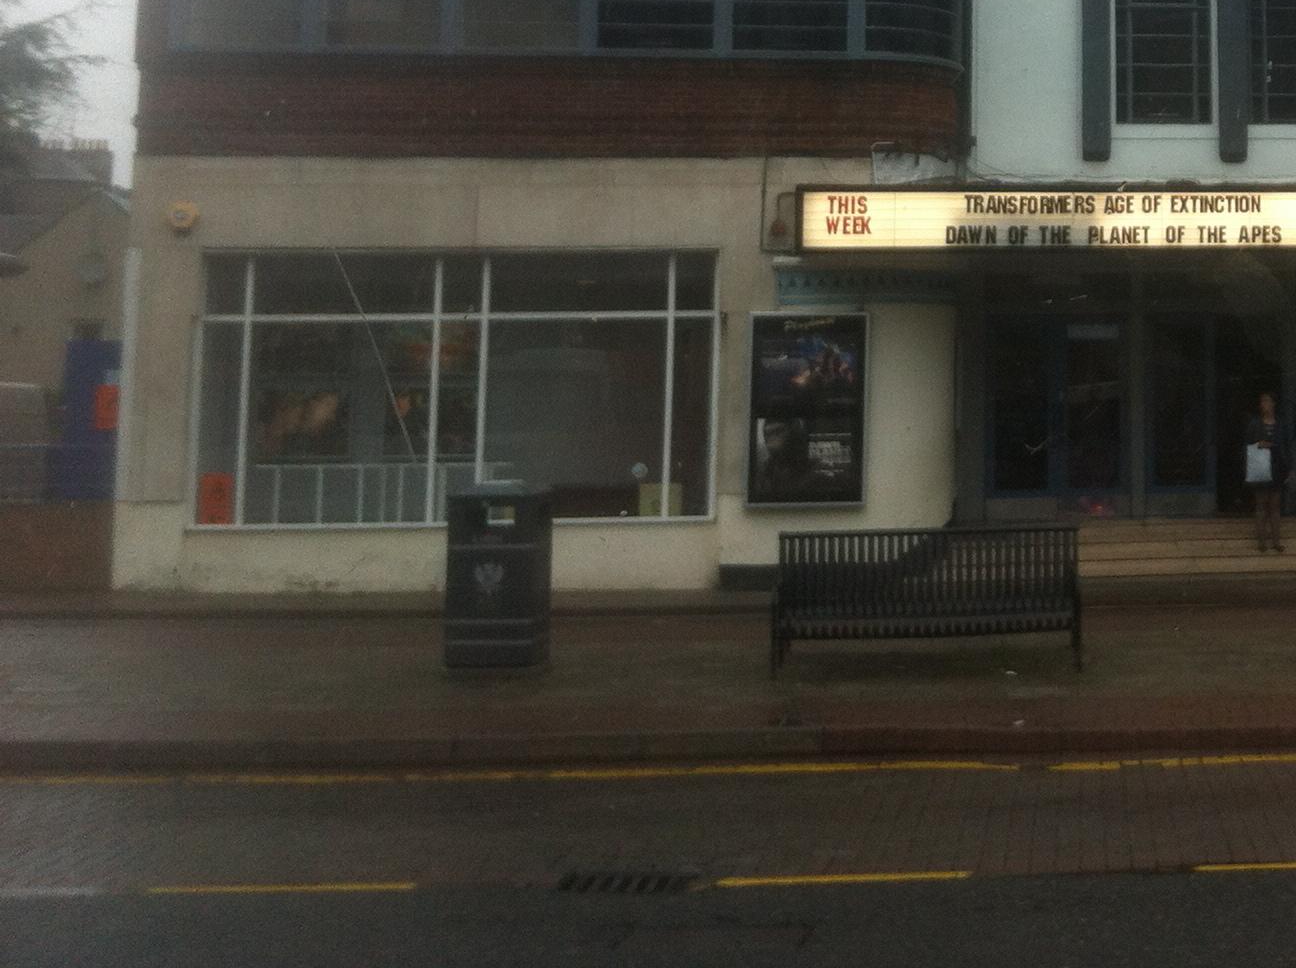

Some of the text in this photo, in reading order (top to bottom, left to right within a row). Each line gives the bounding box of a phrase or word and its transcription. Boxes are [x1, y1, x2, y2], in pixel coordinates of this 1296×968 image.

[827, 195, 868, 214] THIS
[964, 194, 1262, 214] TRANSFORMERS AGE OF EXTINCTION
[826, 216, 871, 235] WEEK
[946, 225, 1282, 245] DAWN OF THE PLANET OF THE APES
